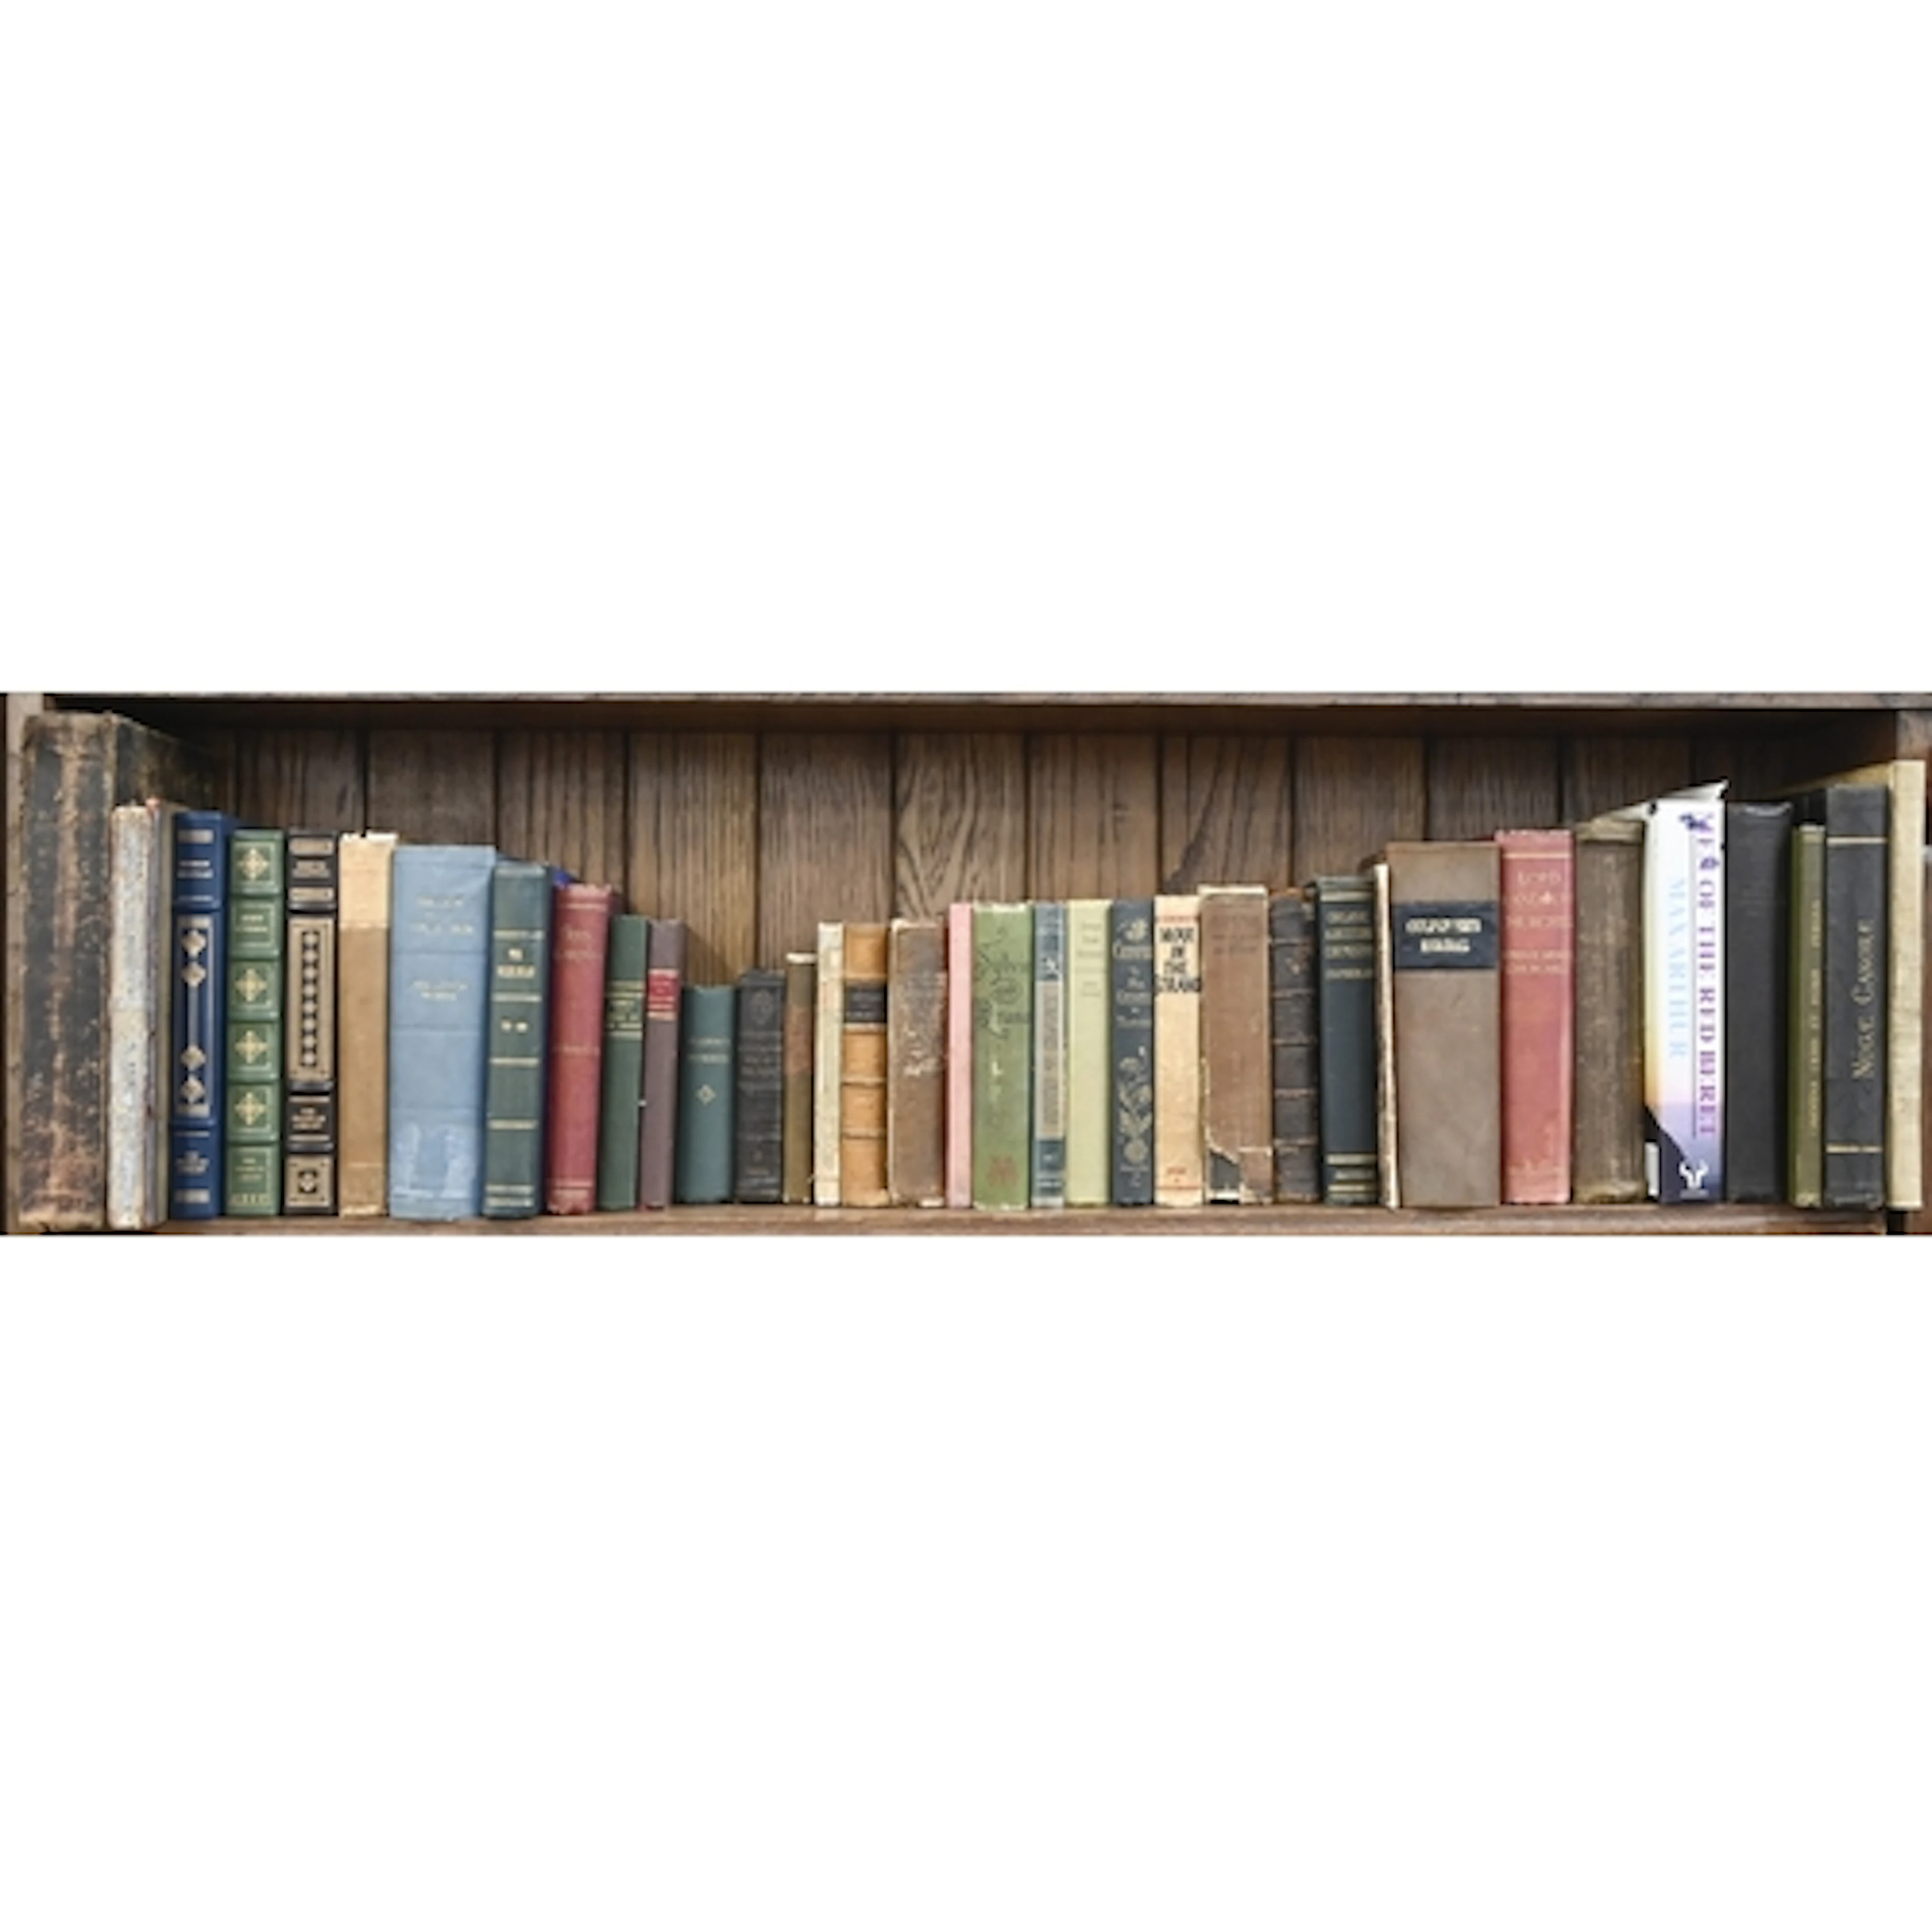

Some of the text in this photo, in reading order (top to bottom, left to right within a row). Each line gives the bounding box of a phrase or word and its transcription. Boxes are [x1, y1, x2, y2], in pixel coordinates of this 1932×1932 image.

[1699, 924, 1715, 978] THE
[1668, 944, 1687, 1059] ARTHUR
[1700, 987, 1716, 1043] RED
[1700, 1050, 1716, 1136] BERET
